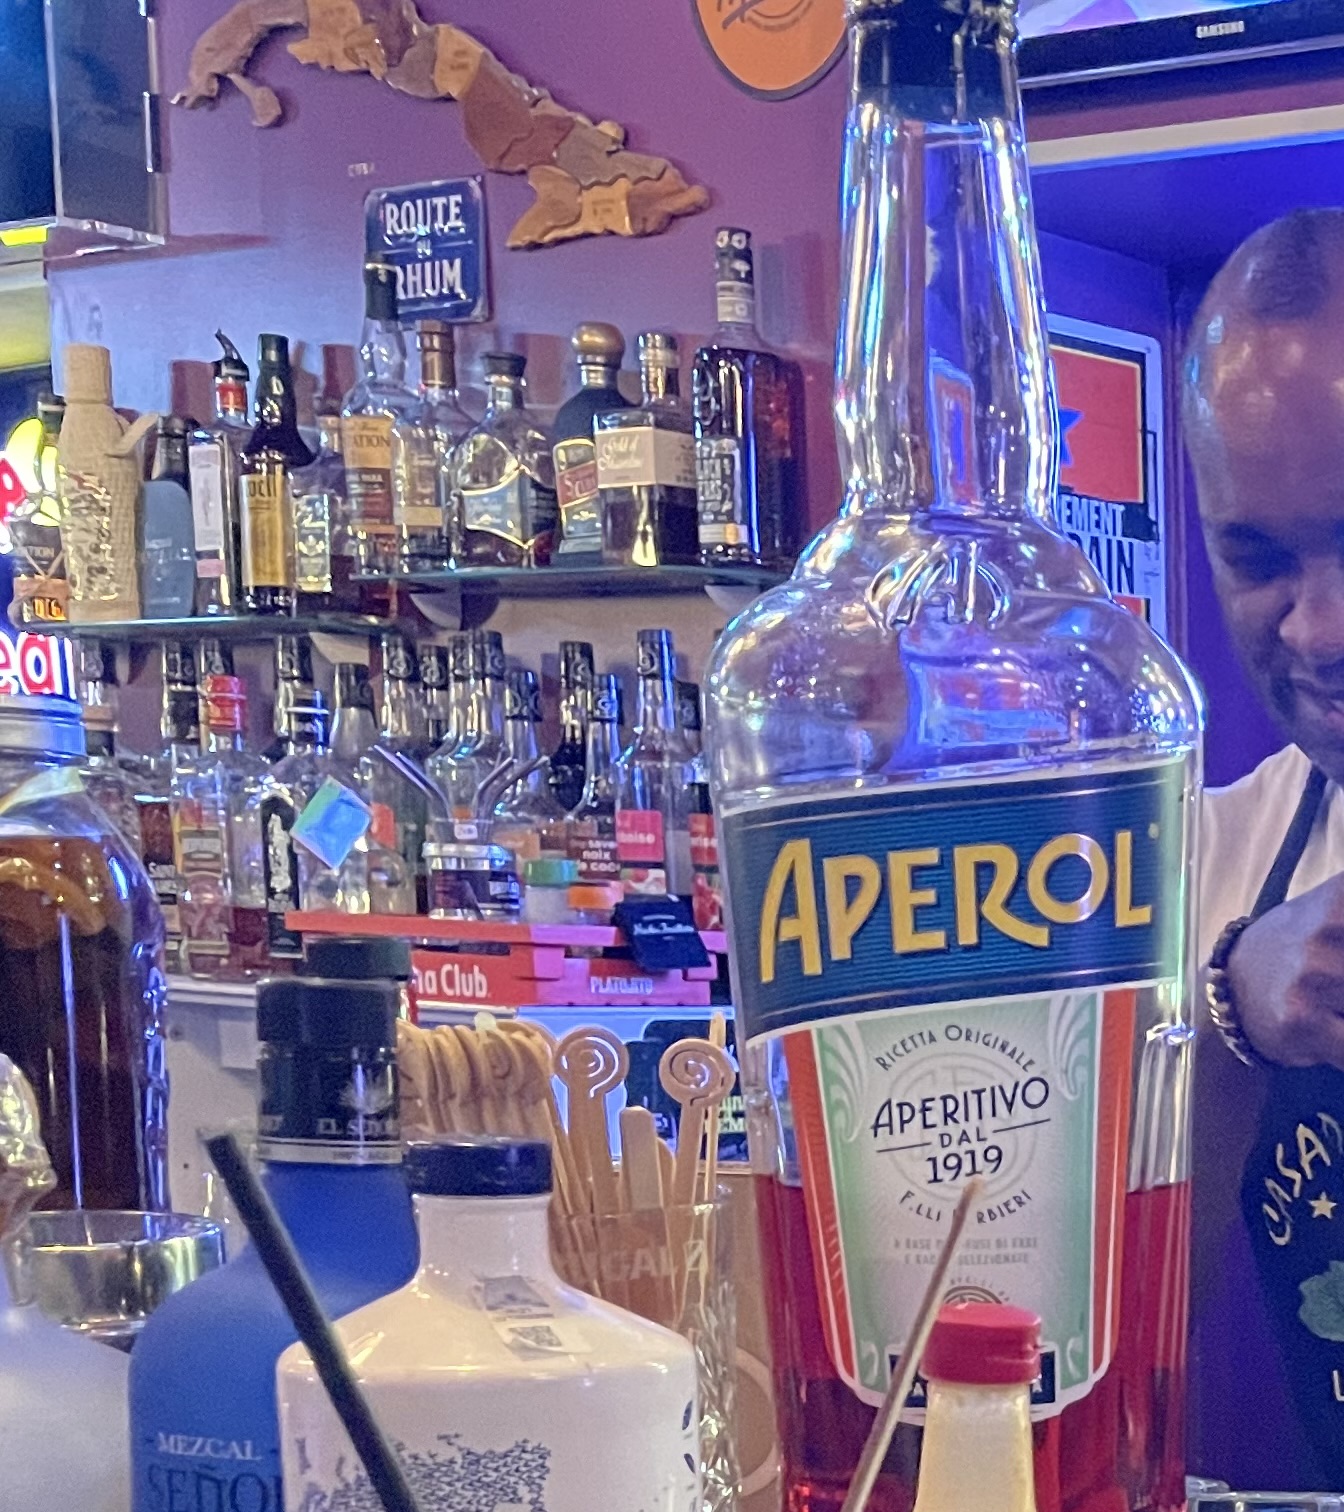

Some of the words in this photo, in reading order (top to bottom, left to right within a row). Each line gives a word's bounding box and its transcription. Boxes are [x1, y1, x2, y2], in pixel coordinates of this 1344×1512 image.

[385, 194, 464, 236] ROUTE
[759, 829, 1153, 984] APEROL
[440, 963, 488, 999] Club
[875, 1029, 938, 1072] RICETTA
[943, 1024, 1037, 1074] ORIGINALE
[870, 1075, 1050, 1139] APERITIVO
[938, 1126, 988, 1149] DAL
[925, 1144, 1004, 1184] 1919
[899, 1189, 942, 1223] F.LLI
[952, 1189, 1033, 1225] RBIERI
[157, 1432, 263, 1461] MEZCAL
